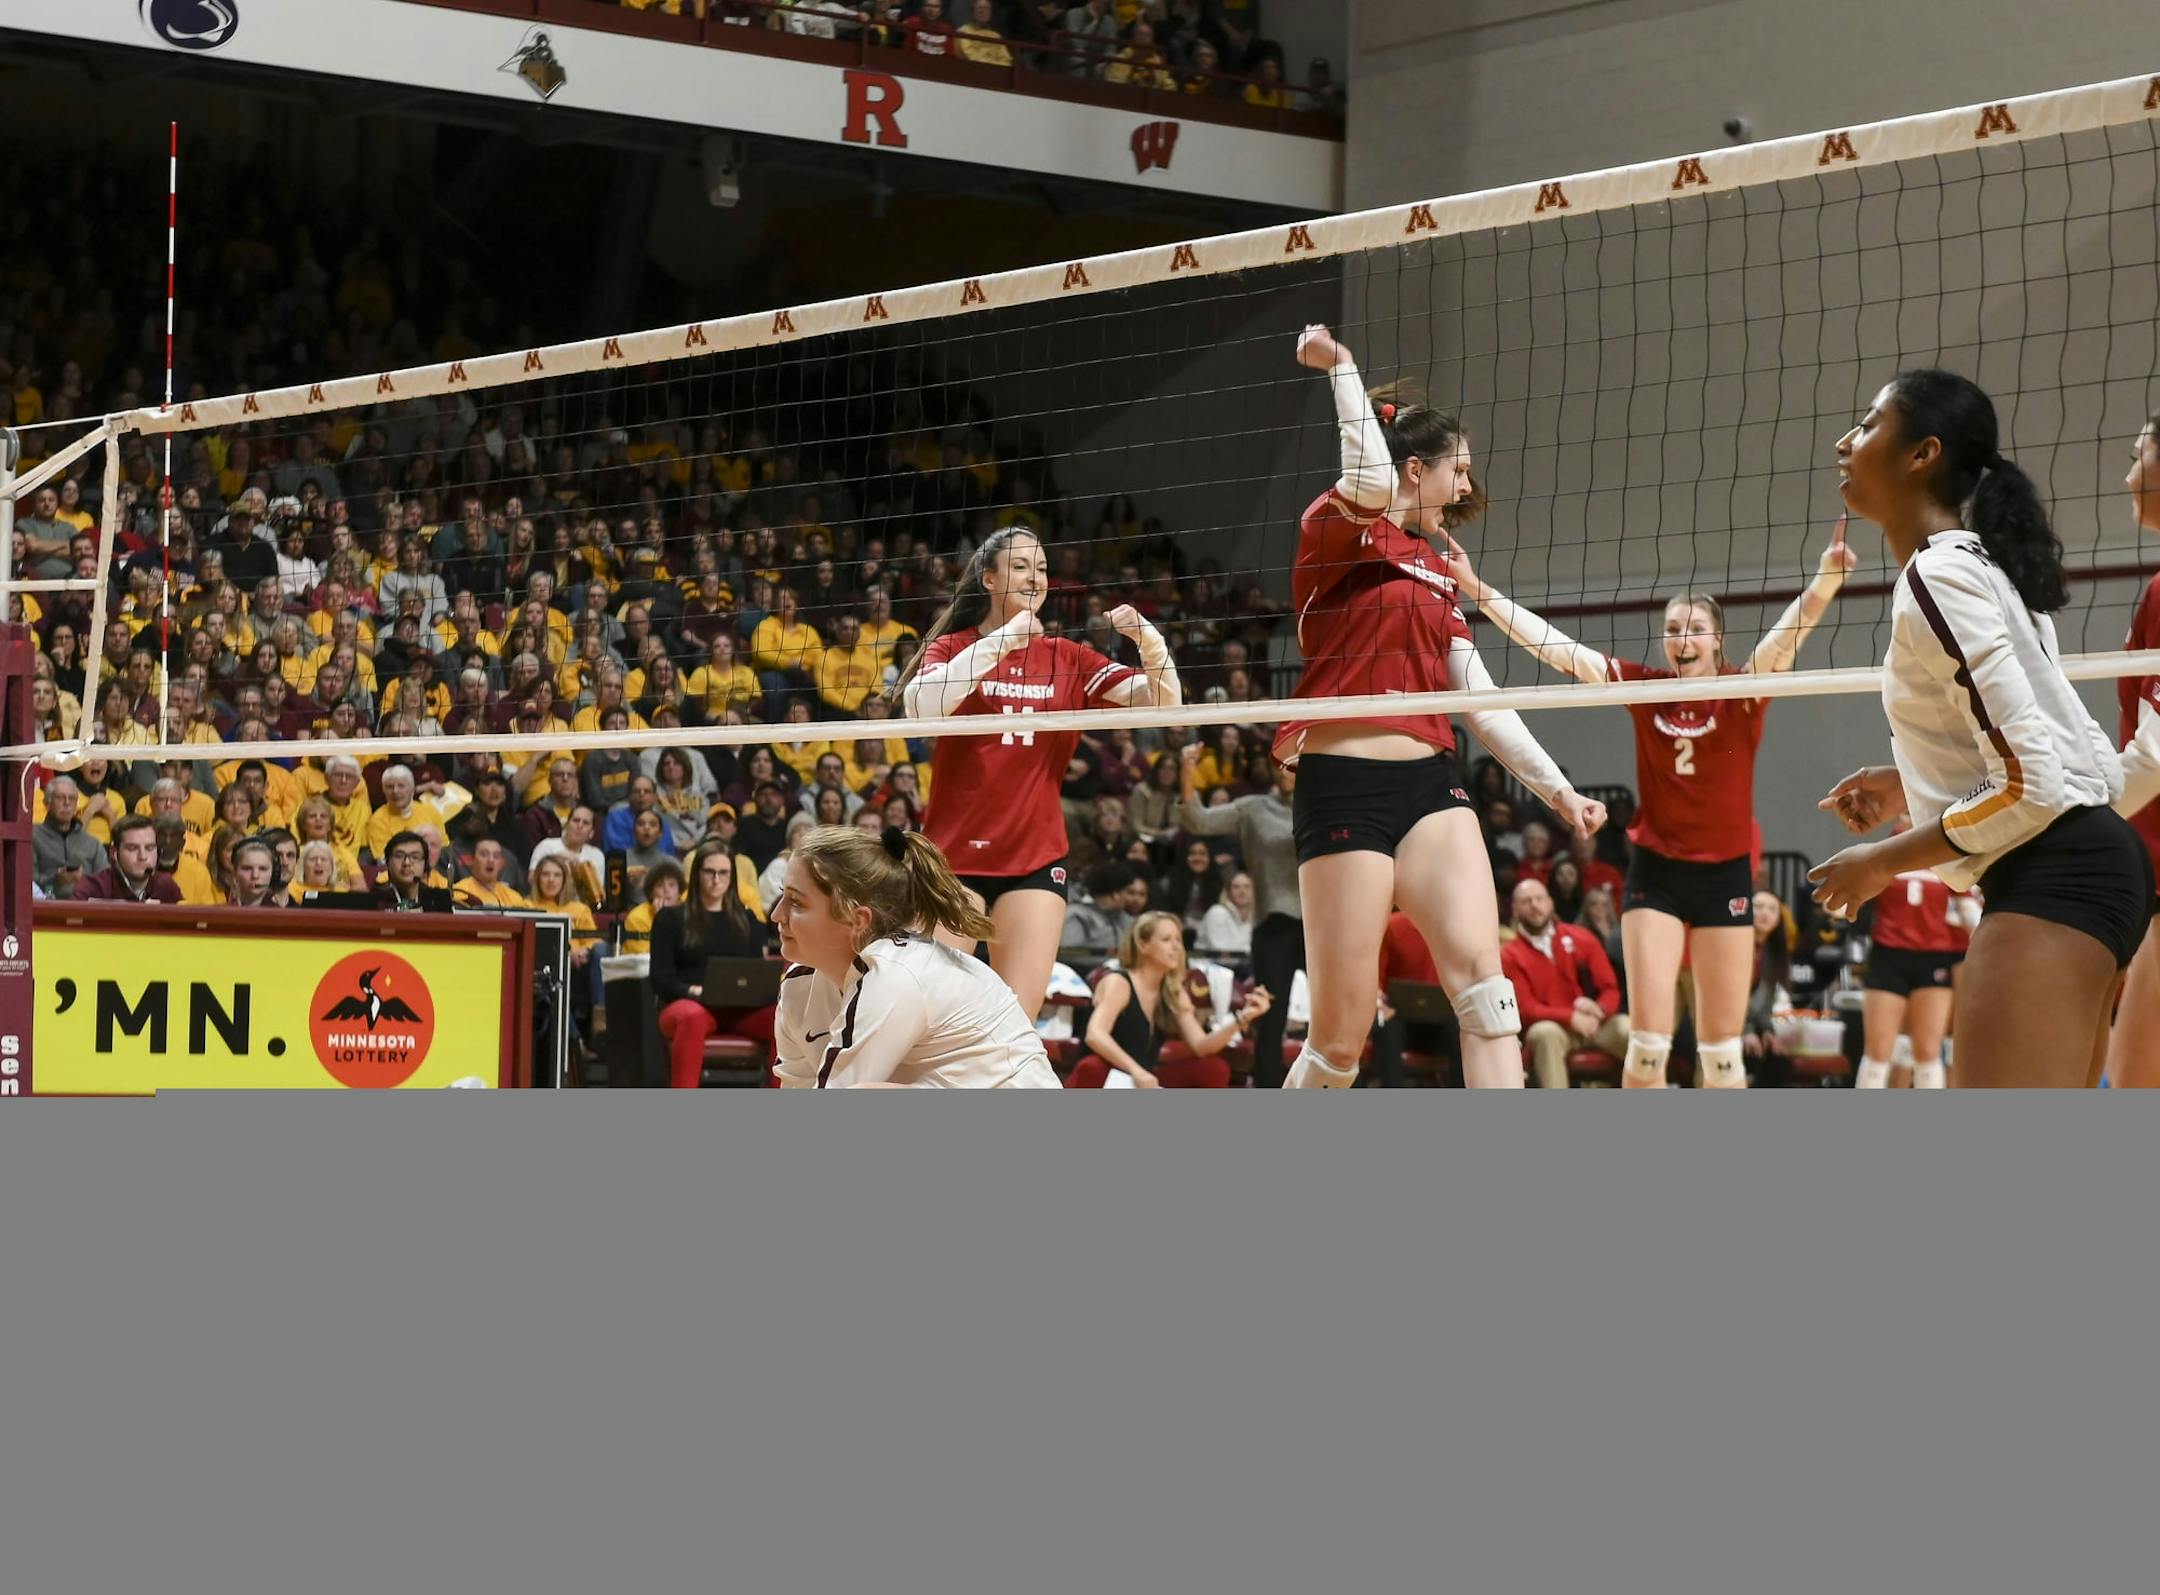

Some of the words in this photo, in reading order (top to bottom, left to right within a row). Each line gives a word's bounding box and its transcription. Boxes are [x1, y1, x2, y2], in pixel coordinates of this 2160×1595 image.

[842, 70, 908, 149] R
[1976, 105, 2015, 138] M
[1129, 122, 1179, 175] W
[1820, 133, 1856, 165] M
[1673, 159, 1707, 189] M
[1536, 183, 1567, 212] M
[1407, 207, 1436, 233] M
[1286, 226, 1314, 253] M
[1172, 246, 1199, 271] M
[1064, 264, 1090, 289] M
[961, 281, 985, 305] M
[865, 298, 887, 321] M
[773, 311, 795, 334] M
[685, 326, 707, 348] M
[603, 339, 624, 360] M
[448, 365, 467, 383] M
[524, 352, 543, 372] M
[308, 387, 324, 402] M
[377, 376, 394, 393] M
[180, 405, 196, 422] M
[243, 396, 259, 413] M
[1674, 737, 1696, 776] 2
[33, 976, 287, 1058] 'MN.
[327, 1033, 416, 1049] MINNESOTA
[335, 1049, 408, 1063] LOTTERY
